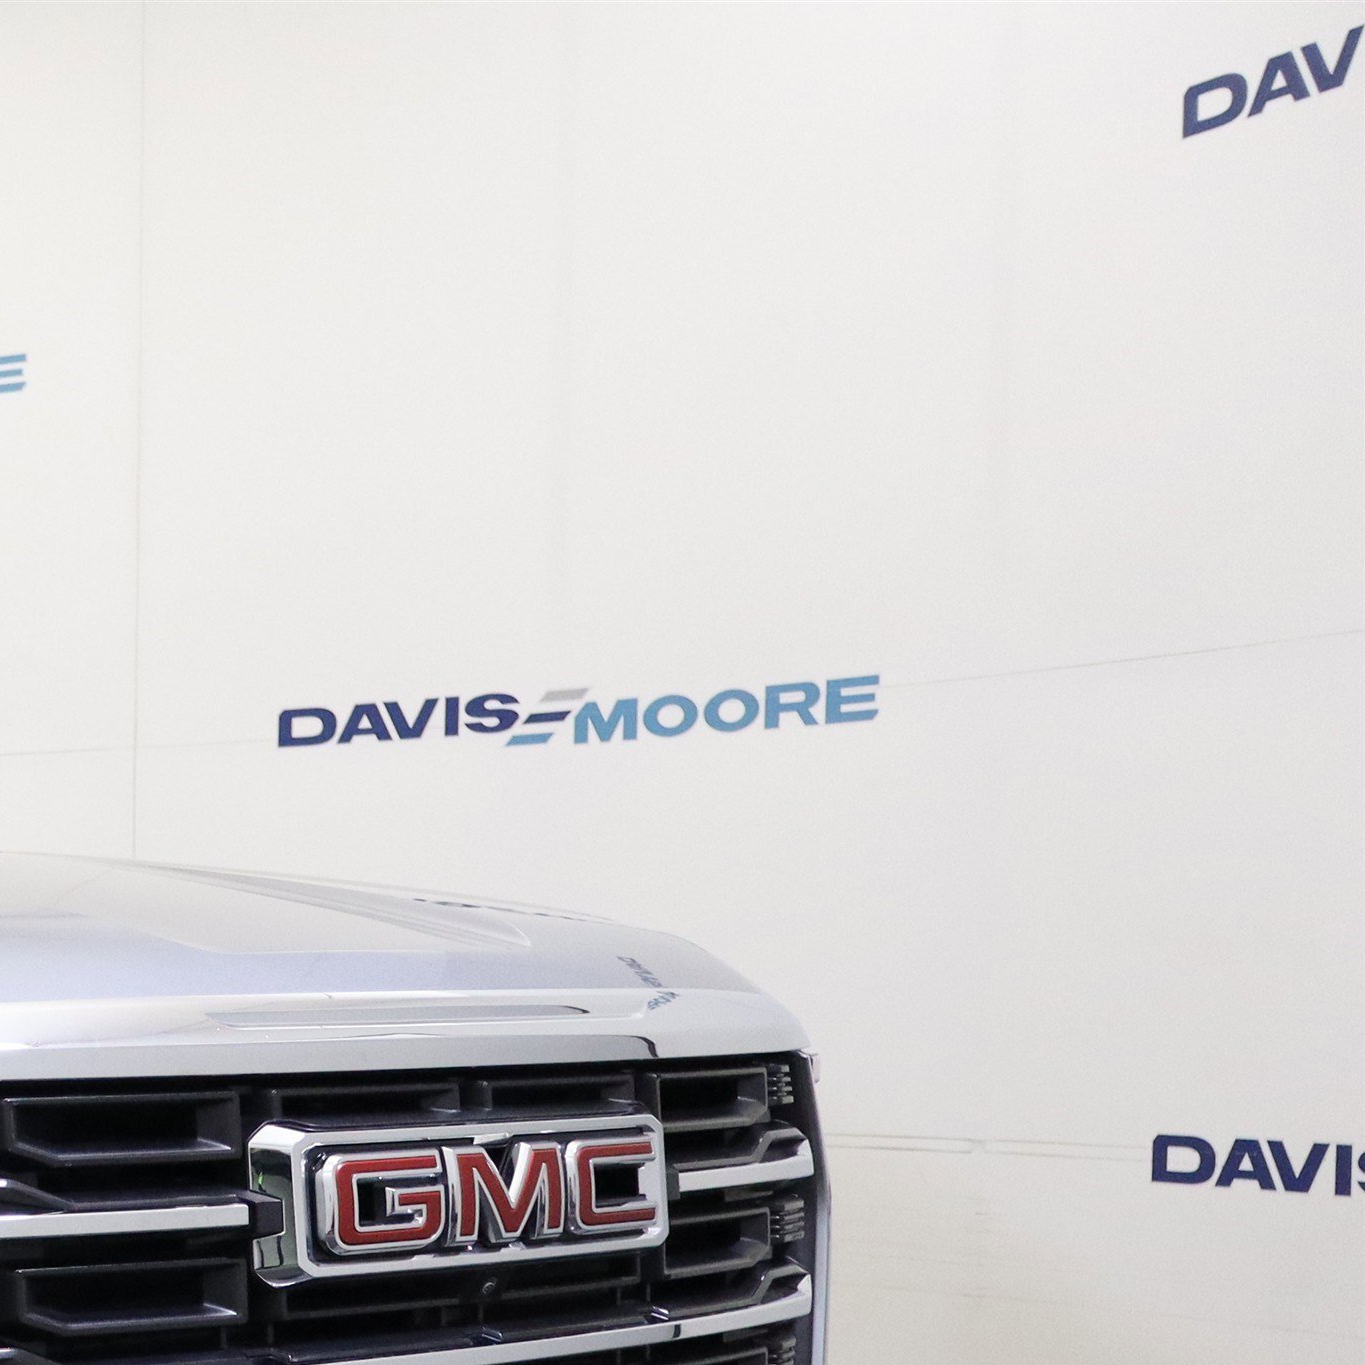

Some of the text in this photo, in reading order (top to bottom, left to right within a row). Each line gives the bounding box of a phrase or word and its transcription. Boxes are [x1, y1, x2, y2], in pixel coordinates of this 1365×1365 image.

[277, 674, 880, 748] DAVIS MOORE
[317, 1137, 658, 1255] GMC
[1151, 1134, 1365, 1197] DAVI
